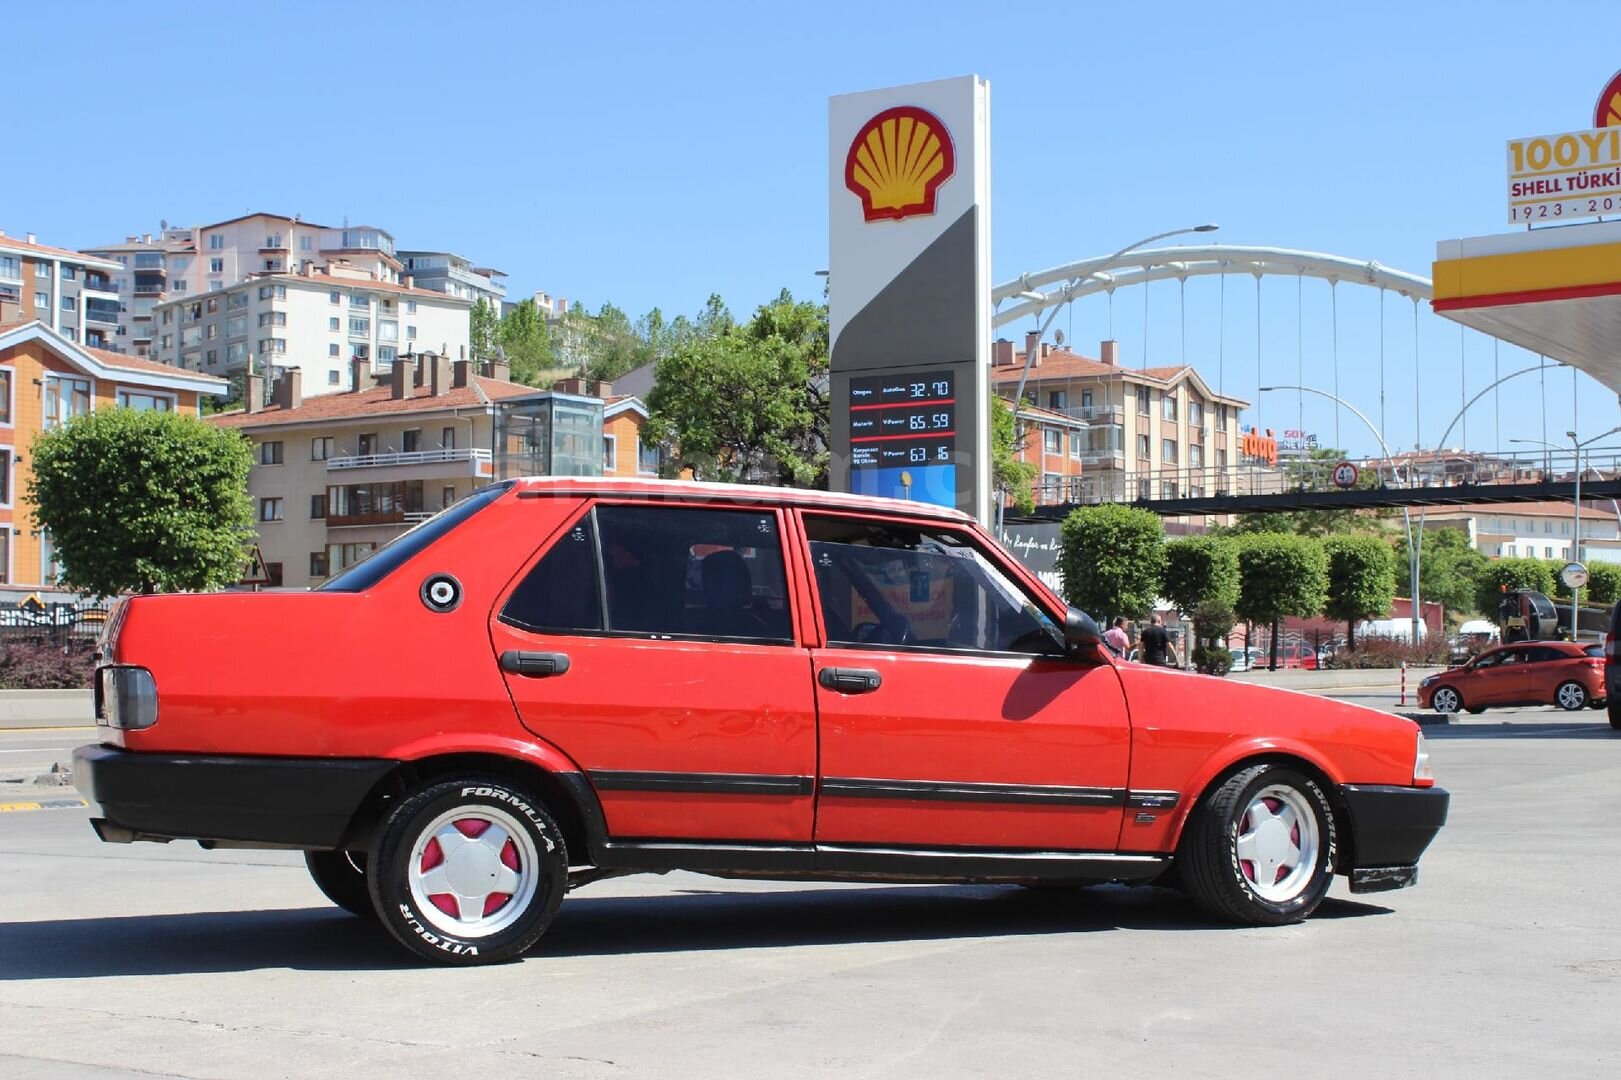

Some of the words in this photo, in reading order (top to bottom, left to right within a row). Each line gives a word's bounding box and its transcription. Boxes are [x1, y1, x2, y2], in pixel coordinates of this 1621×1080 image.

[1511, 178, 1562, 197] SHELL
[1511, 203, 1562, 220] 1923
[1588, 198, 1621, 212] 20
[461, 787, 555, 853] FORMULA
[1305, 779, 1336, 873] FORMULA
[399, 903, 480, 956] VITOUR
